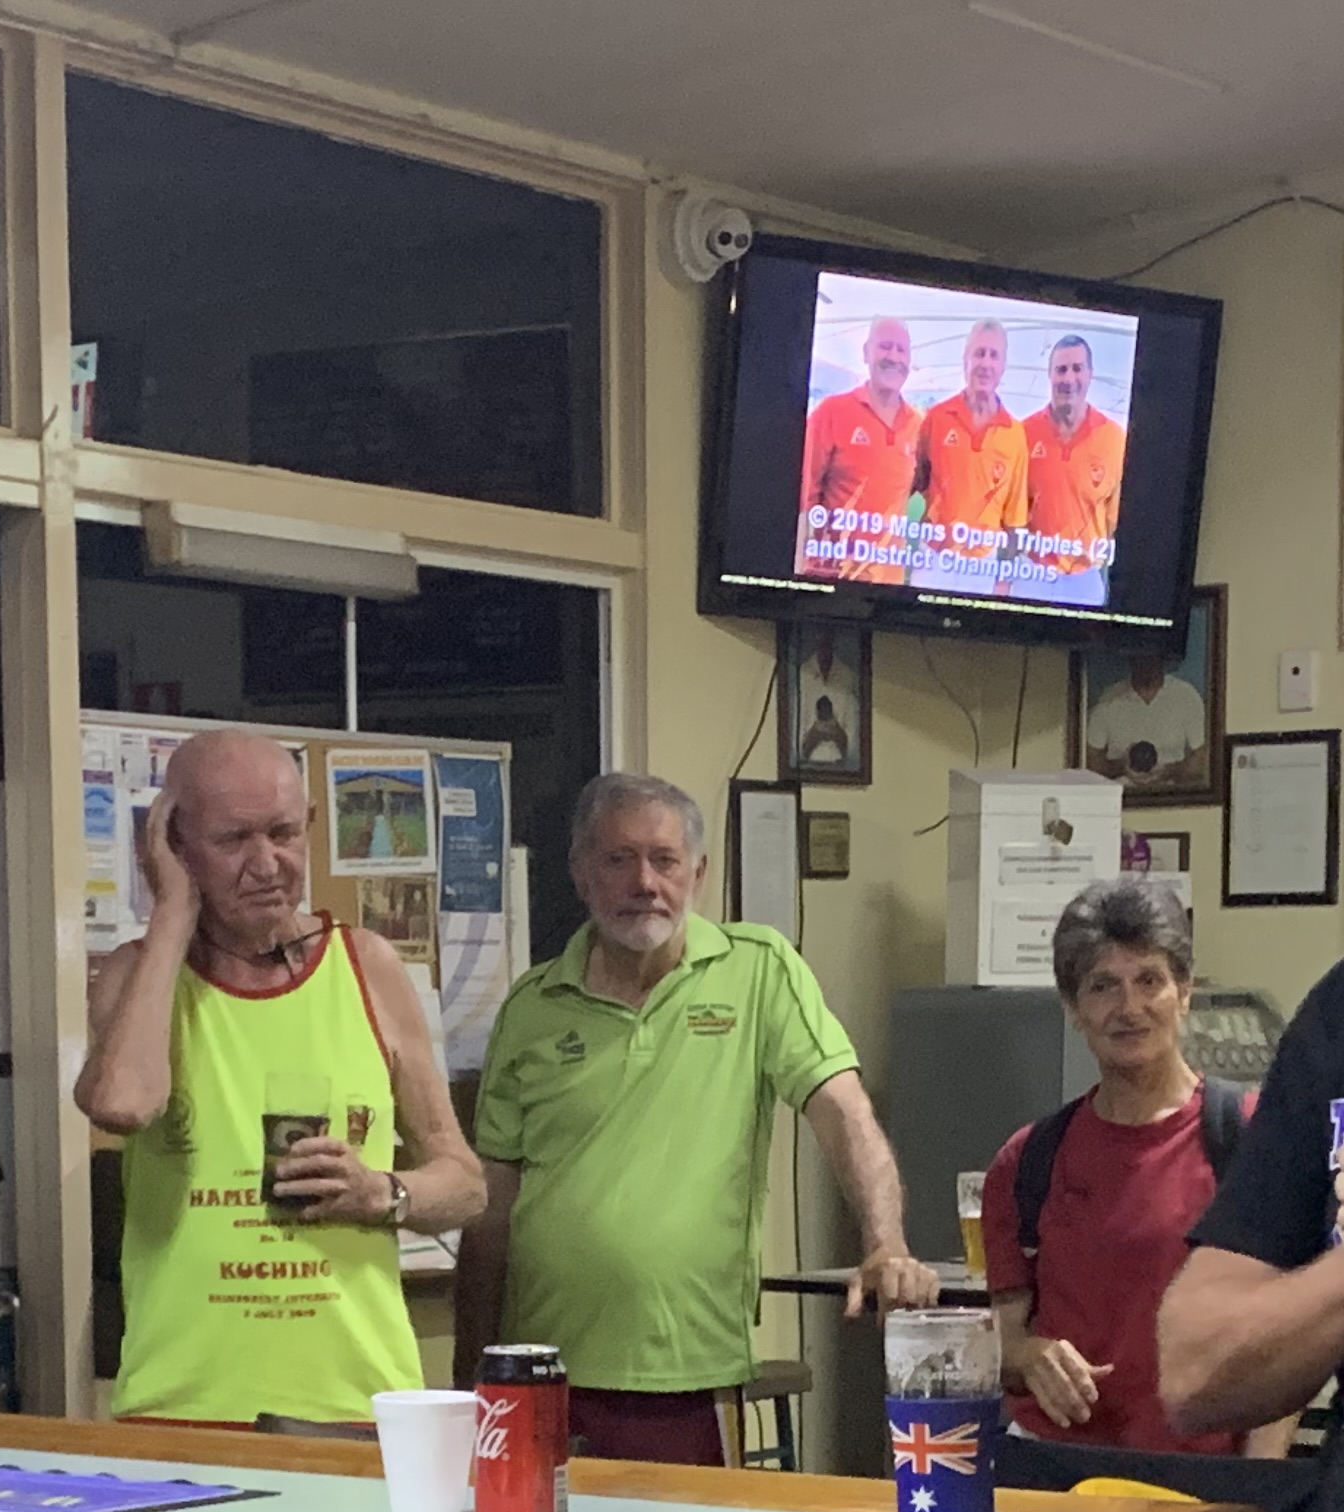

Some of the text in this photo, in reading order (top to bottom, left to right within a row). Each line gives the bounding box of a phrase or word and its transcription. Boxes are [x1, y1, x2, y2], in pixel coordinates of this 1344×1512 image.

[831, 509, 883, 534] 2019
[888, 514, 946, 542] Mens
[952, 522, 1008, 550] Open
[1016, 527, 1083, 559] Triples
[806, 537, 1058, 584] and District Champions
[219, 1259, 332, 1280] KUCHING
